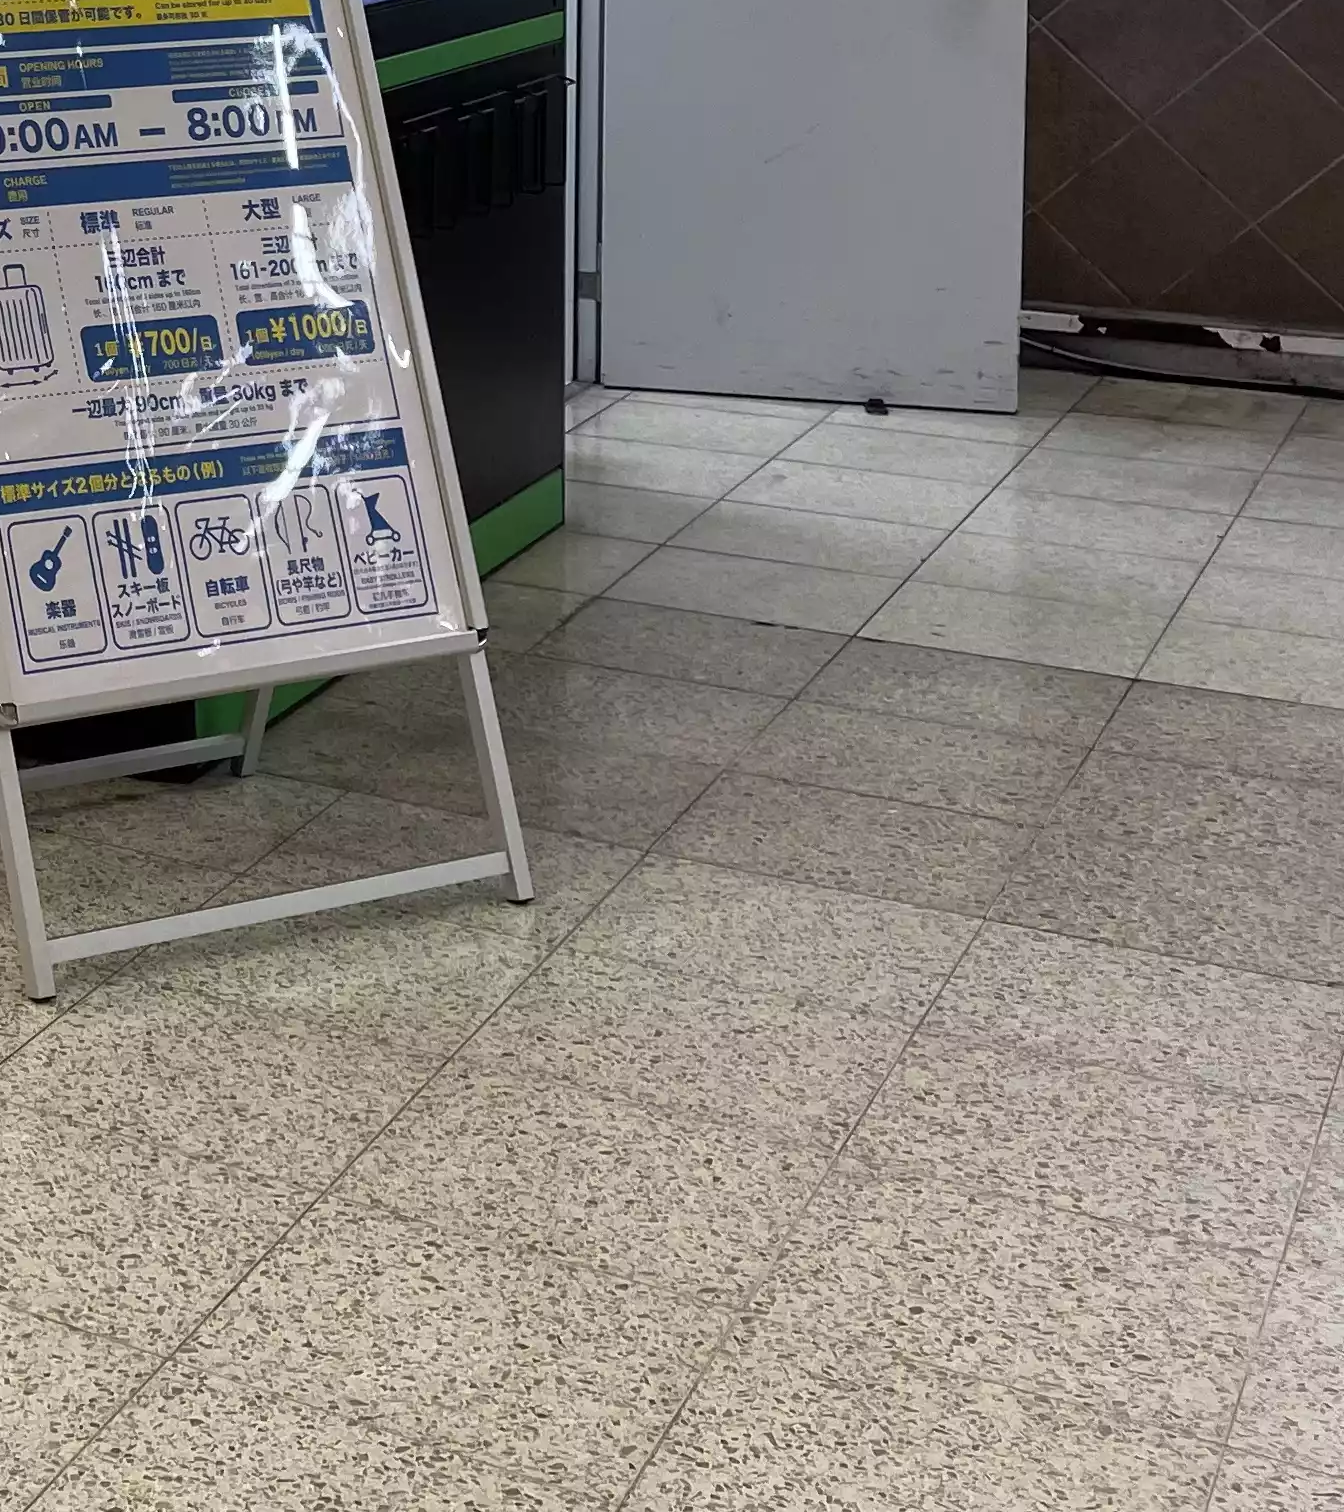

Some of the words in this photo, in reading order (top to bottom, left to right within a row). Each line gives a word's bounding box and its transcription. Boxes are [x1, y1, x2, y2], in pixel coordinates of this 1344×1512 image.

[155, 0, 169, 9] Can
[183, 0, 207, 8] stored
[223, 0, 232, 7] up
[19, 61, 65, 73] OPENING
[68, 58, 103, 69] HOURS
[19, 100, 50, 112] OPEN
[3, 175, 47, 187] CHARGE
[292, 193, 321, 203] LARGE
[132, 206, 174, 217] REGULAR
[242, 197, 281, 221] 大型
[20, 215, 41, 226] SIZE
[80, 210, 120, 234] 標準
[22, 227, 41, 239] 尺寸
[157, 269, 186, 287] まで
[246, 328, 269, 344] 1個
[94, 341, 119, 357] 1個
[280, 379, 308, 397] まで
[354, 547, 414, 565] ベビーカー
[287, 556, 325, 575] 長尺物
[118, 577, 170, 599] スキー板
[205, 575, 250, 598] 自転車
[45, 599, 76, 619] 楽器
[112, 594, 181, 619] スノーボード
[214, 599, 247, 610] BICYCLES
[222, 615, 245, 626] 自行车
